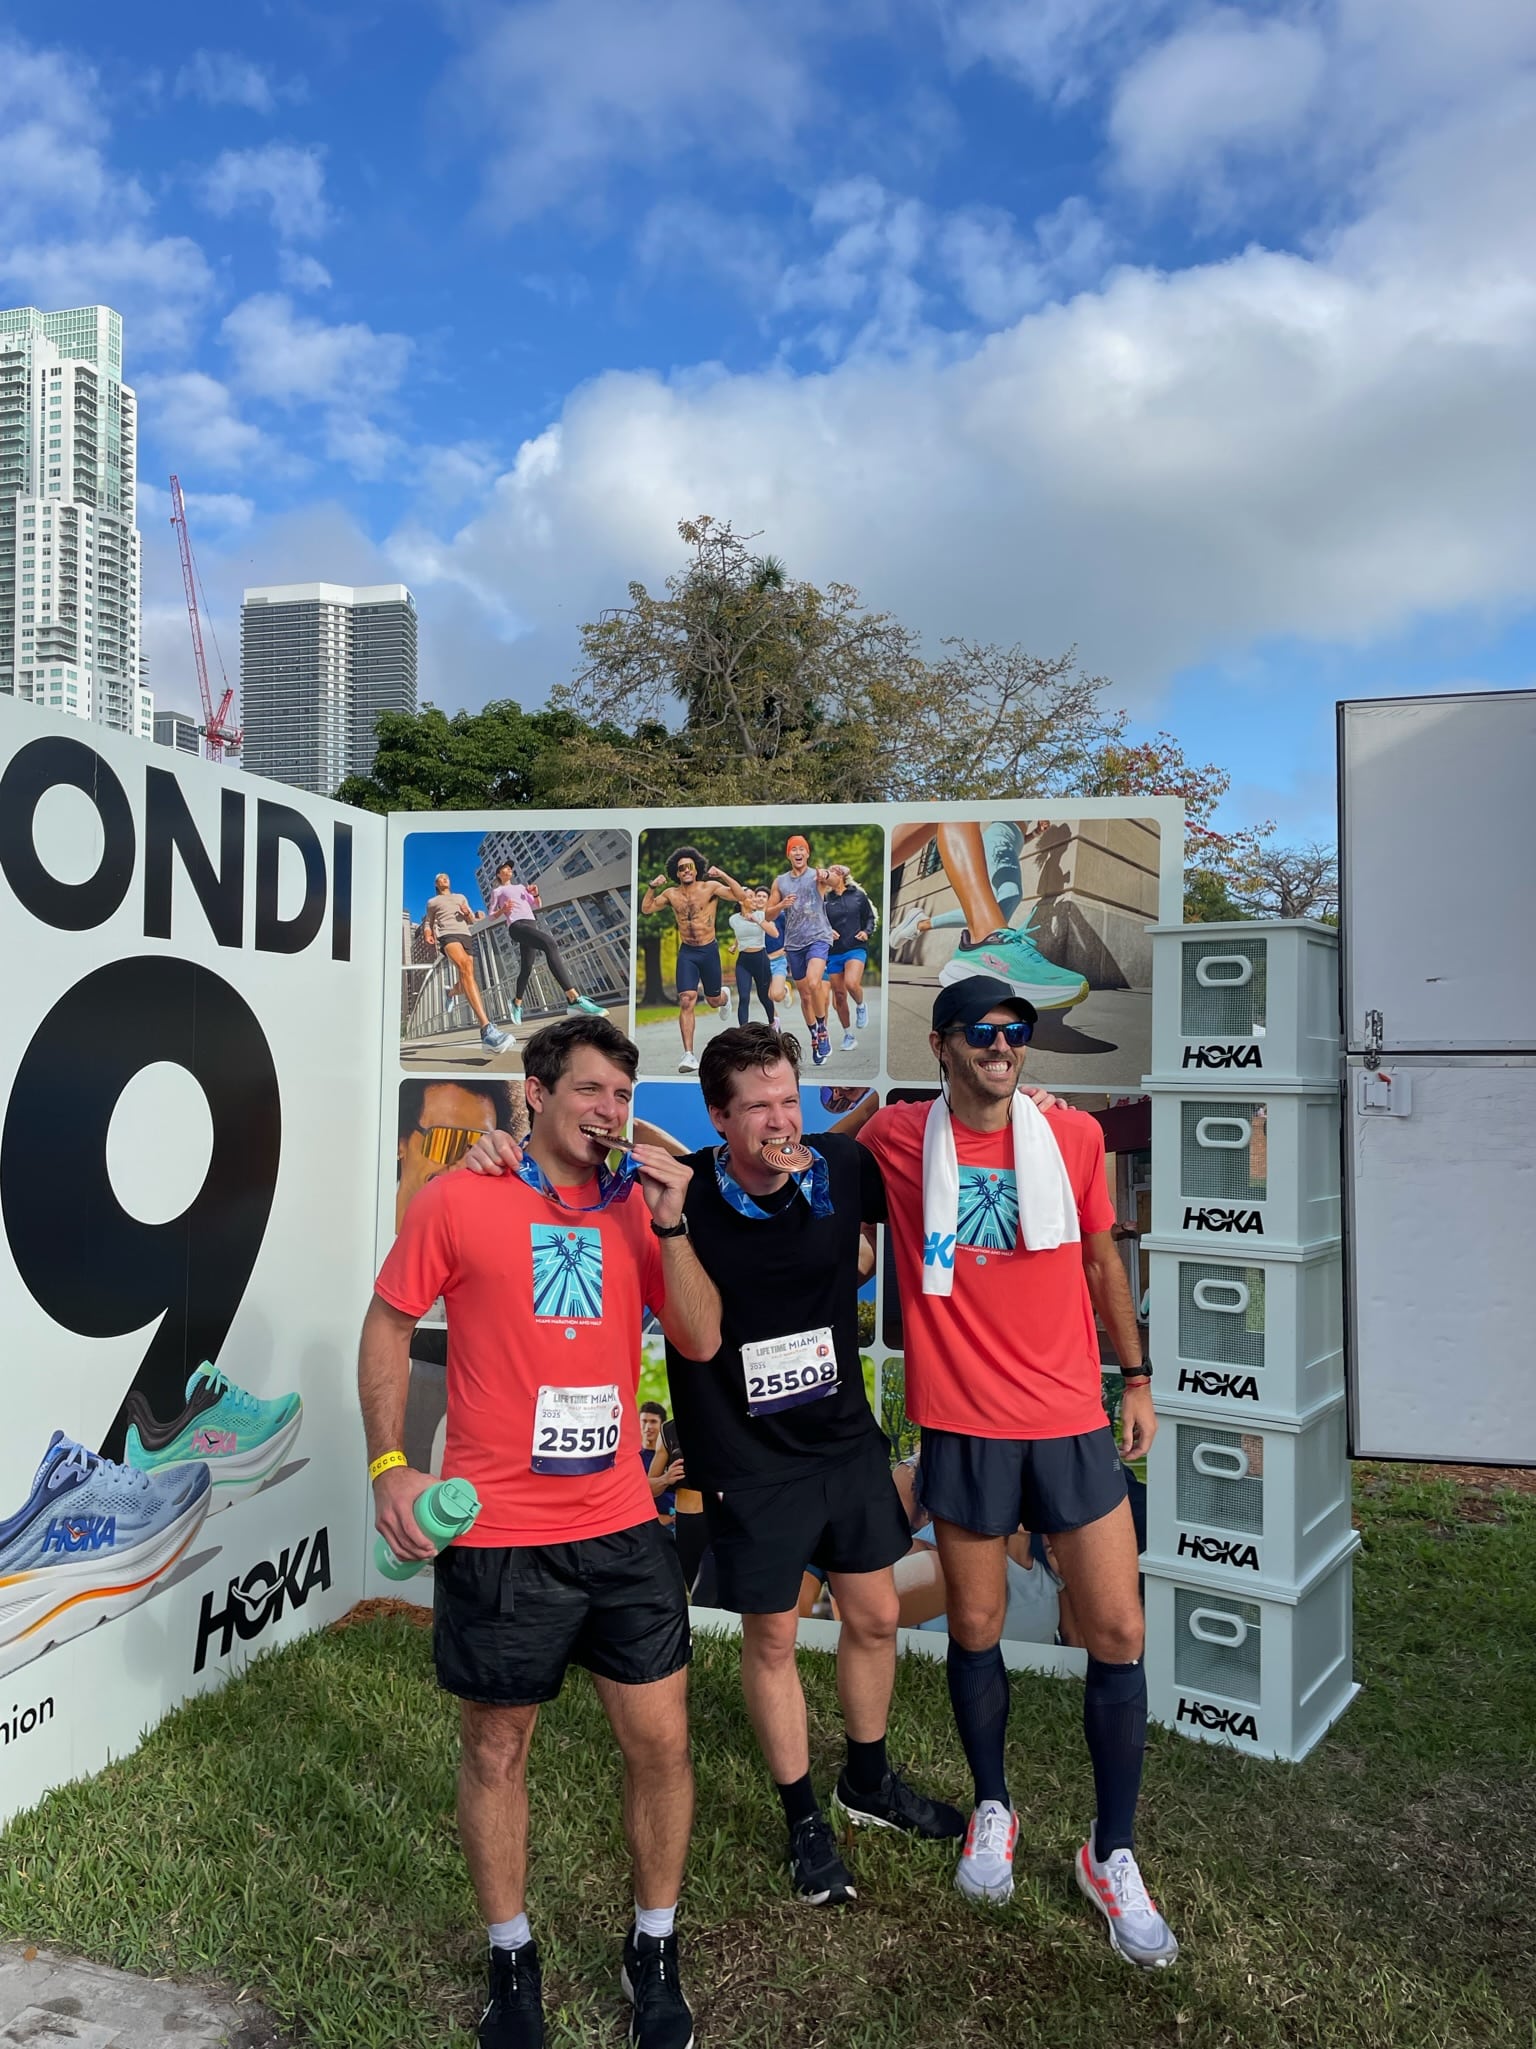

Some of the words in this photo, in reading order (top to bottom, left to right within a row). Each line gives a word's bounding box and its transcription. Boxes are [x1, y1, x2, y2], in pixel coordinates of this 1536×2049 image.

[0, 736, 353, 962] ONDI
[1182, 1045, 1263, 1069] HOKA
[1, 955, 282, 1460] 9
[1182, 1206, 1264, 1235] HOKA
[789, 1336, 818, 1350] MIAMI
[749, 1361, 835, 1398] 25508
[1177, 1369, 1260, 1401] HOKA
[189, 1428, 238, 1454] HOKA
[538, 1424, 618, 1452] 25510
[41, 1516, 116, 1553] HOKA
[1177, 1533, 1260, 1571] HOKA
[193, 1526, 332, 1674] HOKA
[1176, 1698, 1259, 1741] HOKA
